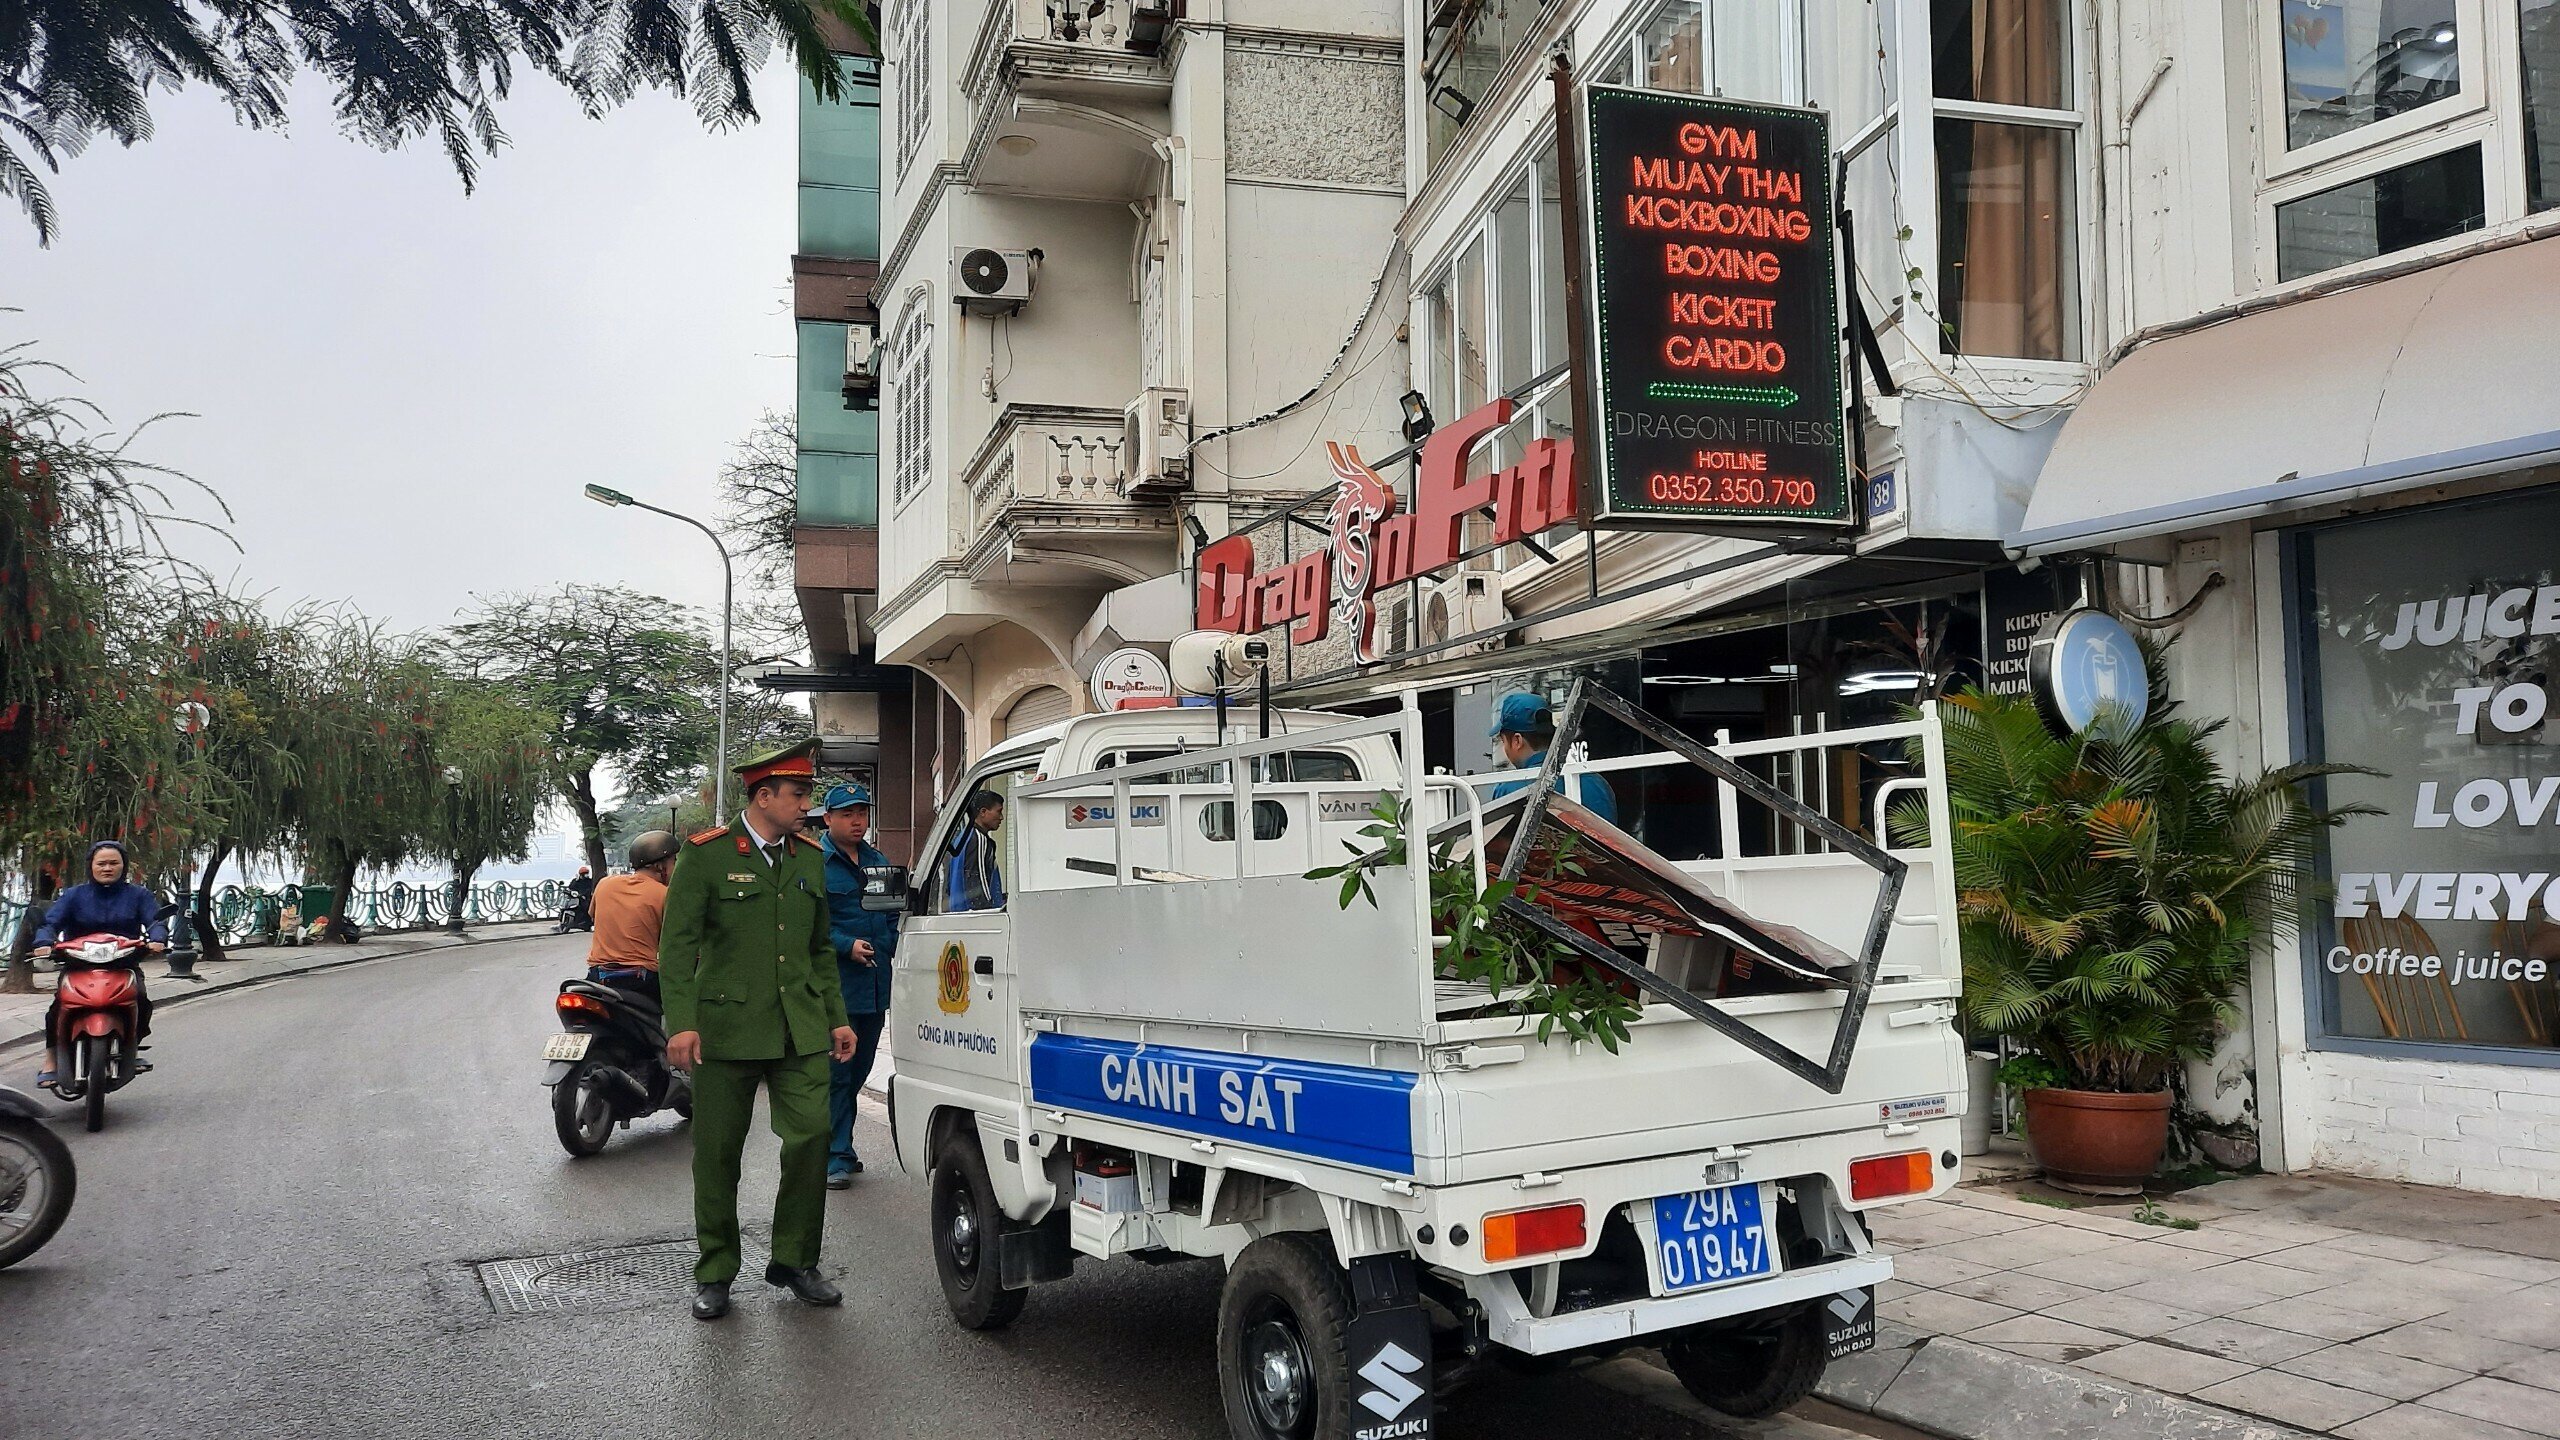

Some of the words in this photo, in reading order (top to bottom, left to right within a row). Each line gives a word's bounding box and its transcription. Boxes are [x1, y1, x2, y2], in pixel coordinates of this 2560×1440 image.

[1680, 123, 1758, 159] GYM
[1634, 156, 1732, 195] MUAY
[1737, 166, 1803, 203] THAI
[1627, 194, 1812, 241] KICKBOXING
[1666, 243, 1781, 282] BOXING
[1672, 292, 1777, 330] KICKFIT
[1665, 334, 1787, 373] CARDIO
[1615, 411, 1737, 442] DRAGON
[1745, 417, 1837, 446] FITNESS
[1699, 451, 1767, 471] HOTLINE
[1650, 473, 1816, 506] 0352.350.790
[1874, 480, 1890, 508] 38
[2379, 584, 2560, 651] JUICE
[2453, 682, 2547, 735] TO
[1090, 805, 1159, 820] SUUKI
[1320, 800, 1356, 813] VÂN
[2412, 777, 2560, 829] LOV
[2325, 945, 2441, 979] Coffee
[2451, 947, 2547, 986] juice
[917, 1019, 941, 1044] CÔNG
[943, 1029, 955, 1047] AN
[957, 1028, 997, 1055] PHƯỜNG
[1101, 1042, 1197, 1116] CẢNH
[1219, 1062, 1302, 1134] SÁT
[1680, 1186, 1739, 1233] 29A
[1662, 1224, 1764, 1286] 019.47
[1828, 1320, 1872, 1345] SUZUKI
[1830, 1344, 1850, 1358] VÂN
[1851, 1337, 1872, 1351] ĐẠO
[1355, 1418, 1428, 1440] SUZUKI
